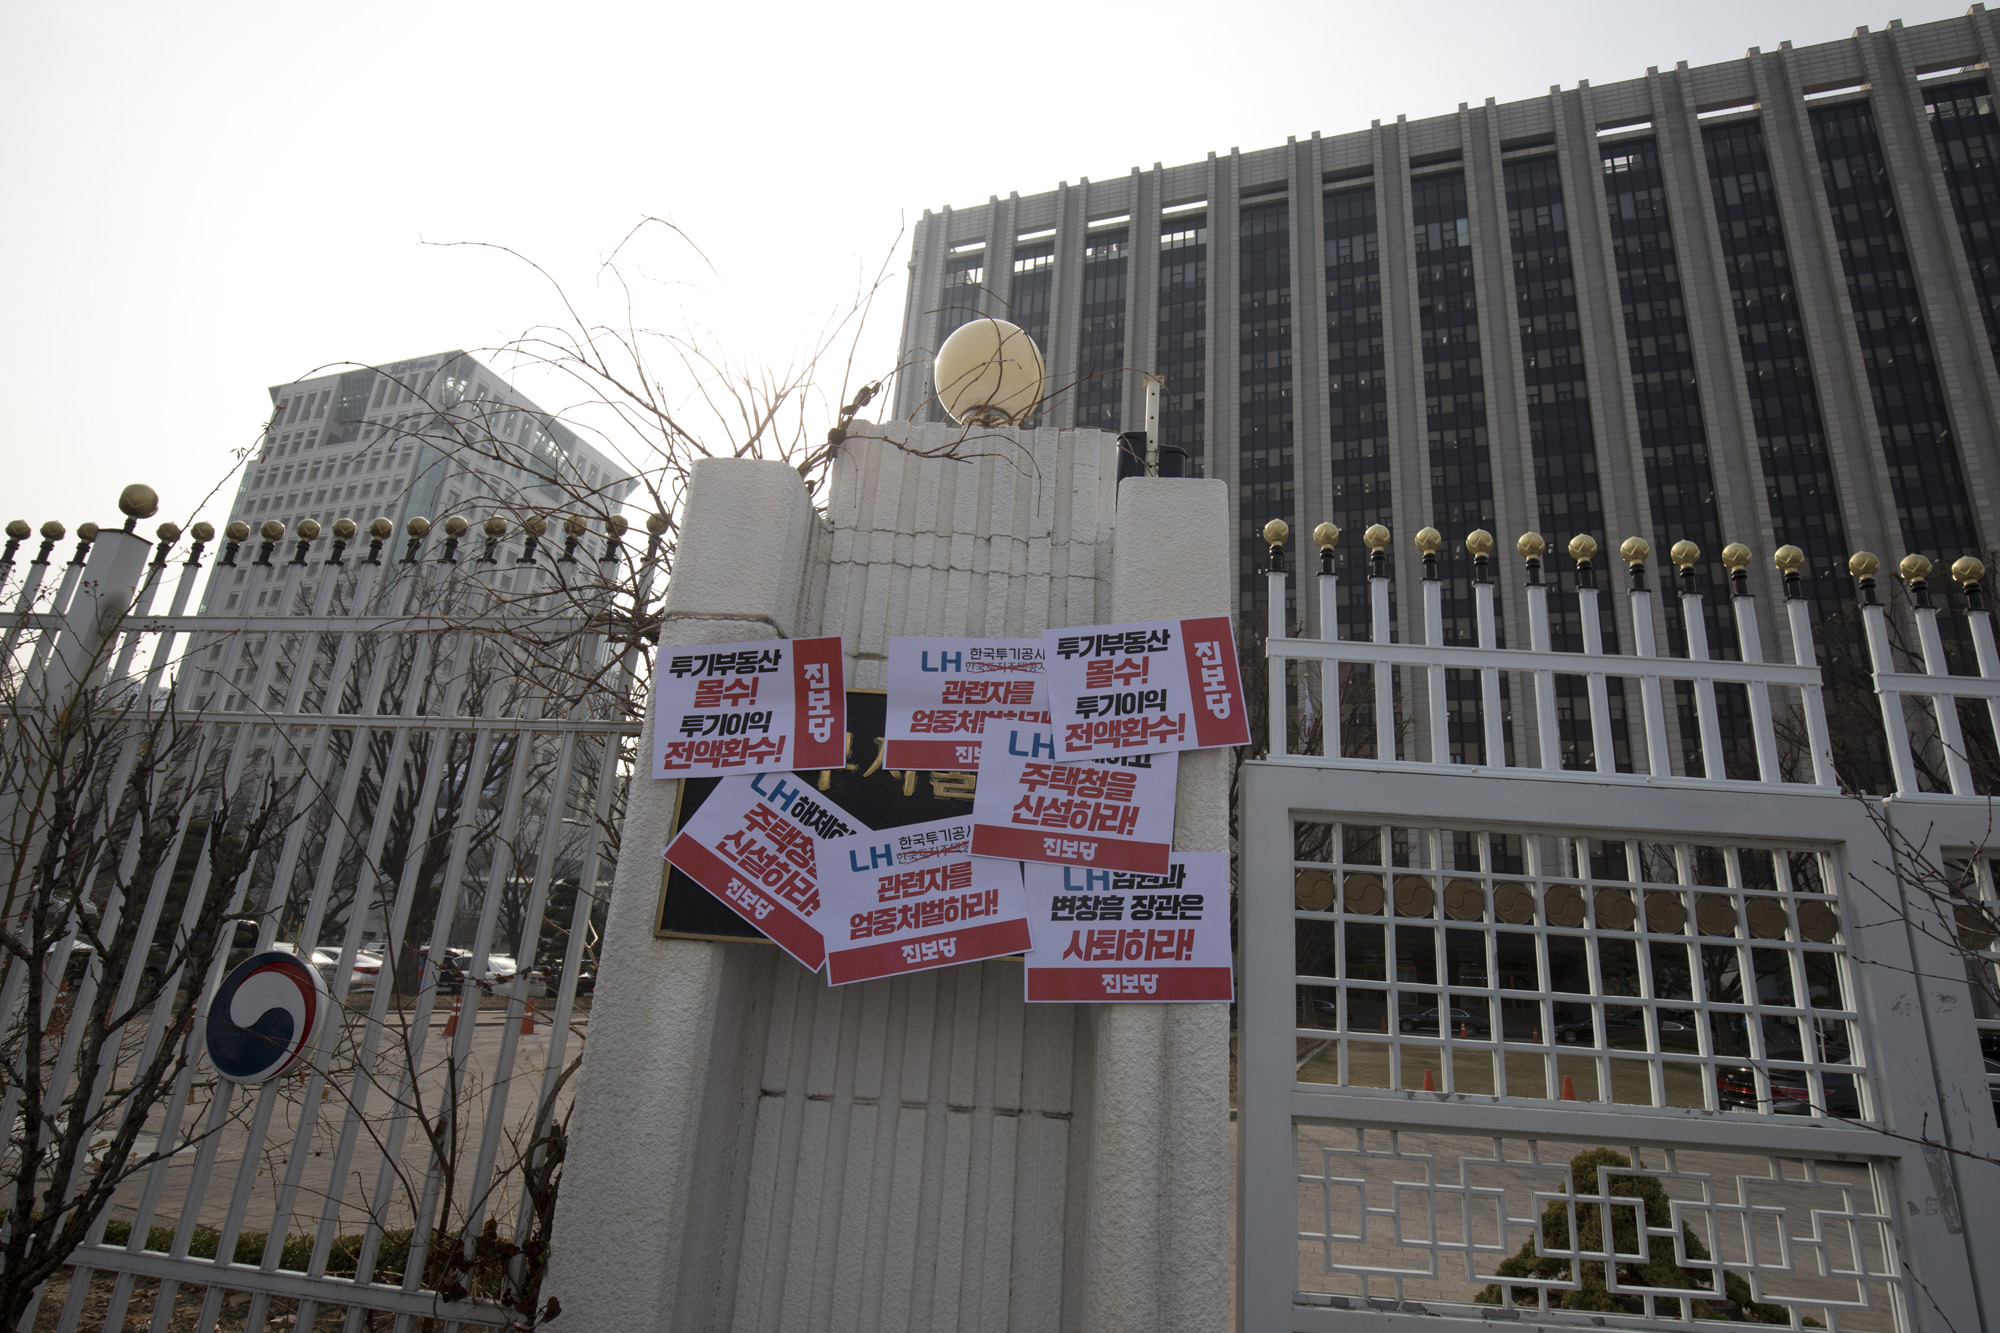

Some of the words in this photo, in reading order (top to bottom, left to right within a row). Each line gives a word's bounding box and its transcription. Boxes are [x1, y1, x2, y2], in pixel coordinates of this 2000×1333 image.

[1056, 628, 1170, 660] 투기부동산
[669, 649, 782, 679] 투기부동산
[921, 650, 962, 672] LH
[1085, 656, 1150, 690] 몰수!
[693, 676, 760, 708] 몰수!
[941, 680, 1035, 705] 관련자를
[1194, 640, 1232, 720] 진보당
[803, 662, 835, 743] 진보당
[1075, 688, 1168, 719] 투기이익
[679, 711, 773, 738] 투기이익
[1064, 713, 1186, 752] 전액환수!
[663, 735, 787, 770] 전액환수!
[1019, 762, 1138, 803] 주택청을
[1011, 795, 1140, 836] 신설하라!
[743, 802, 818, 880] 주택청
[1043, 837, 1098, 861] 진보당
[849, 843, 893, 872] LH
[877, 861, 972, 903] 관련자를
[725, 877, 775, 920] 진보당
[850, 888, 999, 941] 엄중처벌하라!
[1050, 894, 1125, 922] 변창흠
[1130, 894, 1204, 921] 장관은
[901, 937, 957, 964] 진보당
[1062, 928, 1195, 961] 사퇴하라!
[1101, 974, 1159, 994] 진보당
